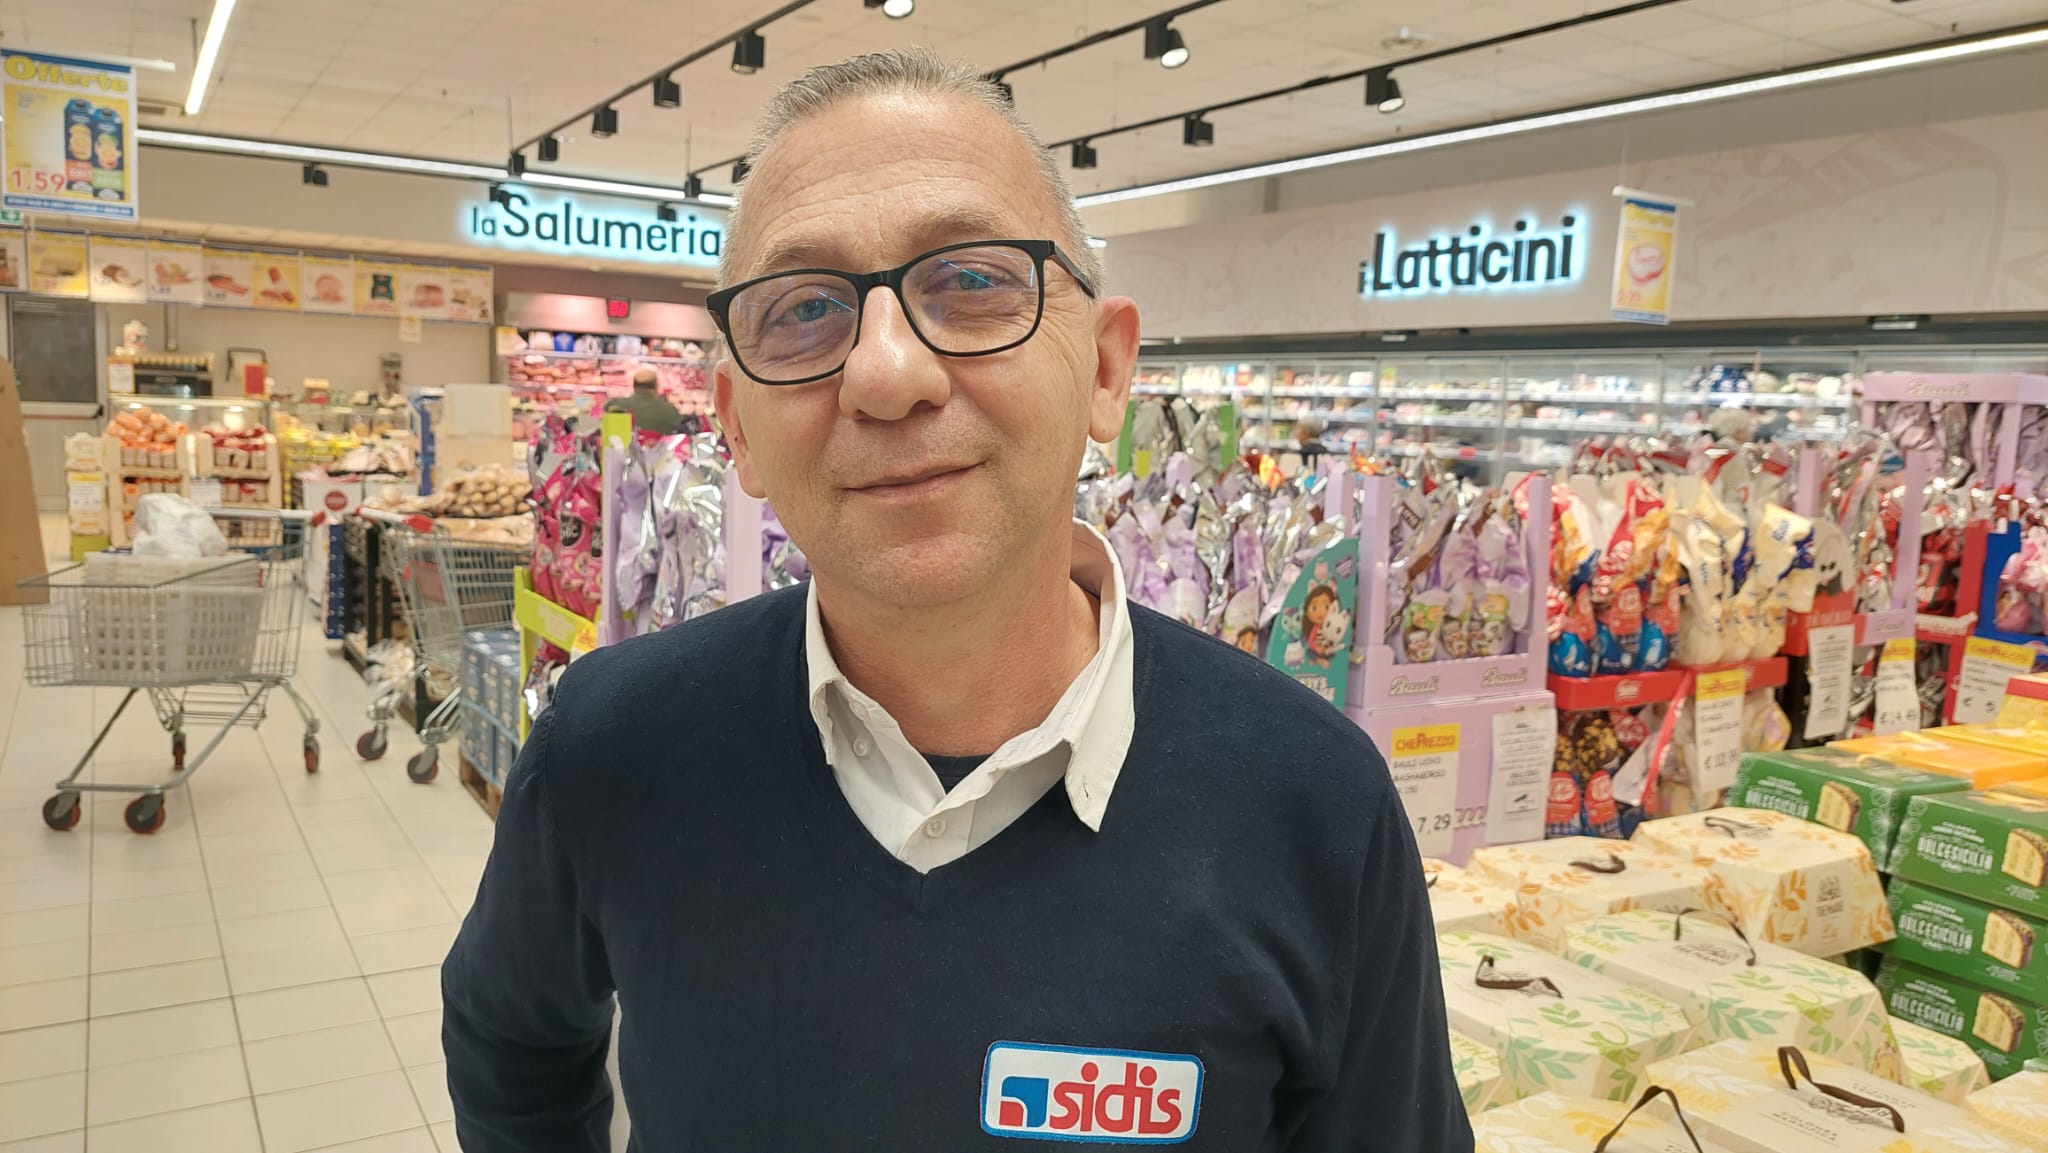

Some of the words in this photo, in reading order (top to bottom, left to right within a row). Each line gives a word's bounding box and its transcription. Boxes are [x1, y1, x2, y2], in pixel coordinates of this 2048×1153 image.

[4, 55, 128, 92] Offerte
[11, 170, 66, 193] 1,59
[473, 207, 496, 236] la
[502, 191, 720, 256] Salumeria
[1358, 260, 1368, 293] i
[1373, 215, 1575, 291] Latticini
[1418, 814, 1451, 835] 7,29
[1049, 1061, 1182, 1135] sidis
